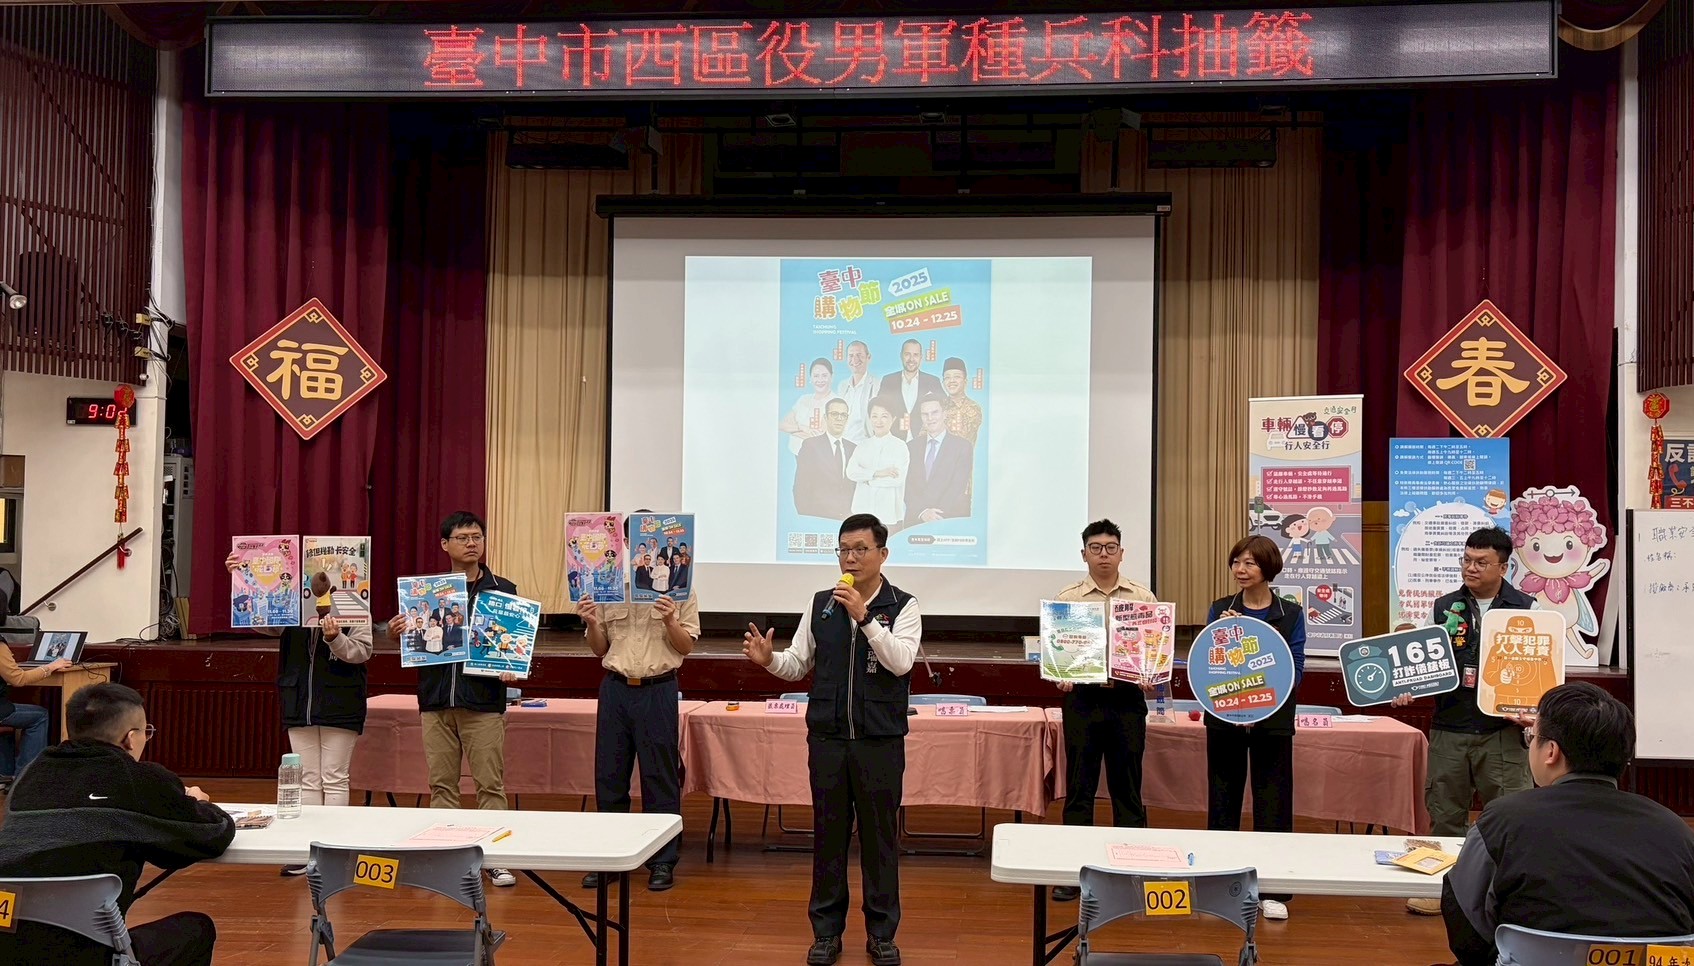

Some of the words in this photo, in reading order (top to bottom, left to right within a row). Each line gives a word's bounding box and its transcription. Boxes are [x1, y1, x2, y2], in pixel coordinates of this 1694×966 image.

[423, 11, 1314, 88] 臺中市西區役男軍種兵科抽籤
[818, 266, 862, 294] 臺中
[892, 272, 929, 294] 2025
[814, 281, 882, 321] 購物節
[907, 298, 924, 312] ON
[924, 291, 950, 308] SALE
[891, 318, 921, 331] 10.24
[931, 310, 958, 325] 12.25
[266, 339, 349, 400] 福
[1436, 337, 1531, 407] 春
[1285, 440, 1330, 451] 行人安全行
[1211, 624, 1245, 646] 臺中
[1495, 634, 1551, 646] 打擊犯罪
[1208, 635, 1260, 668] 購物節
[1388, 637, 1446, 667] 165
[1495, 644, 1551, 657] 人人有責
[1250, 655, 1274, 669] 2025
[1228, 681, 1241, 693] ON
[1241, 675, 1265, 689] SALE
[1214, 697, 1239, 708] 10.24
[1247, 692, 1273, 704] 12.25
[1513, 698, 1521, 706] 10
[356, 859, 394, 884] 003
[1146, 888, 1188, 911] 002
[1588, 948, 1636, 966] 001
